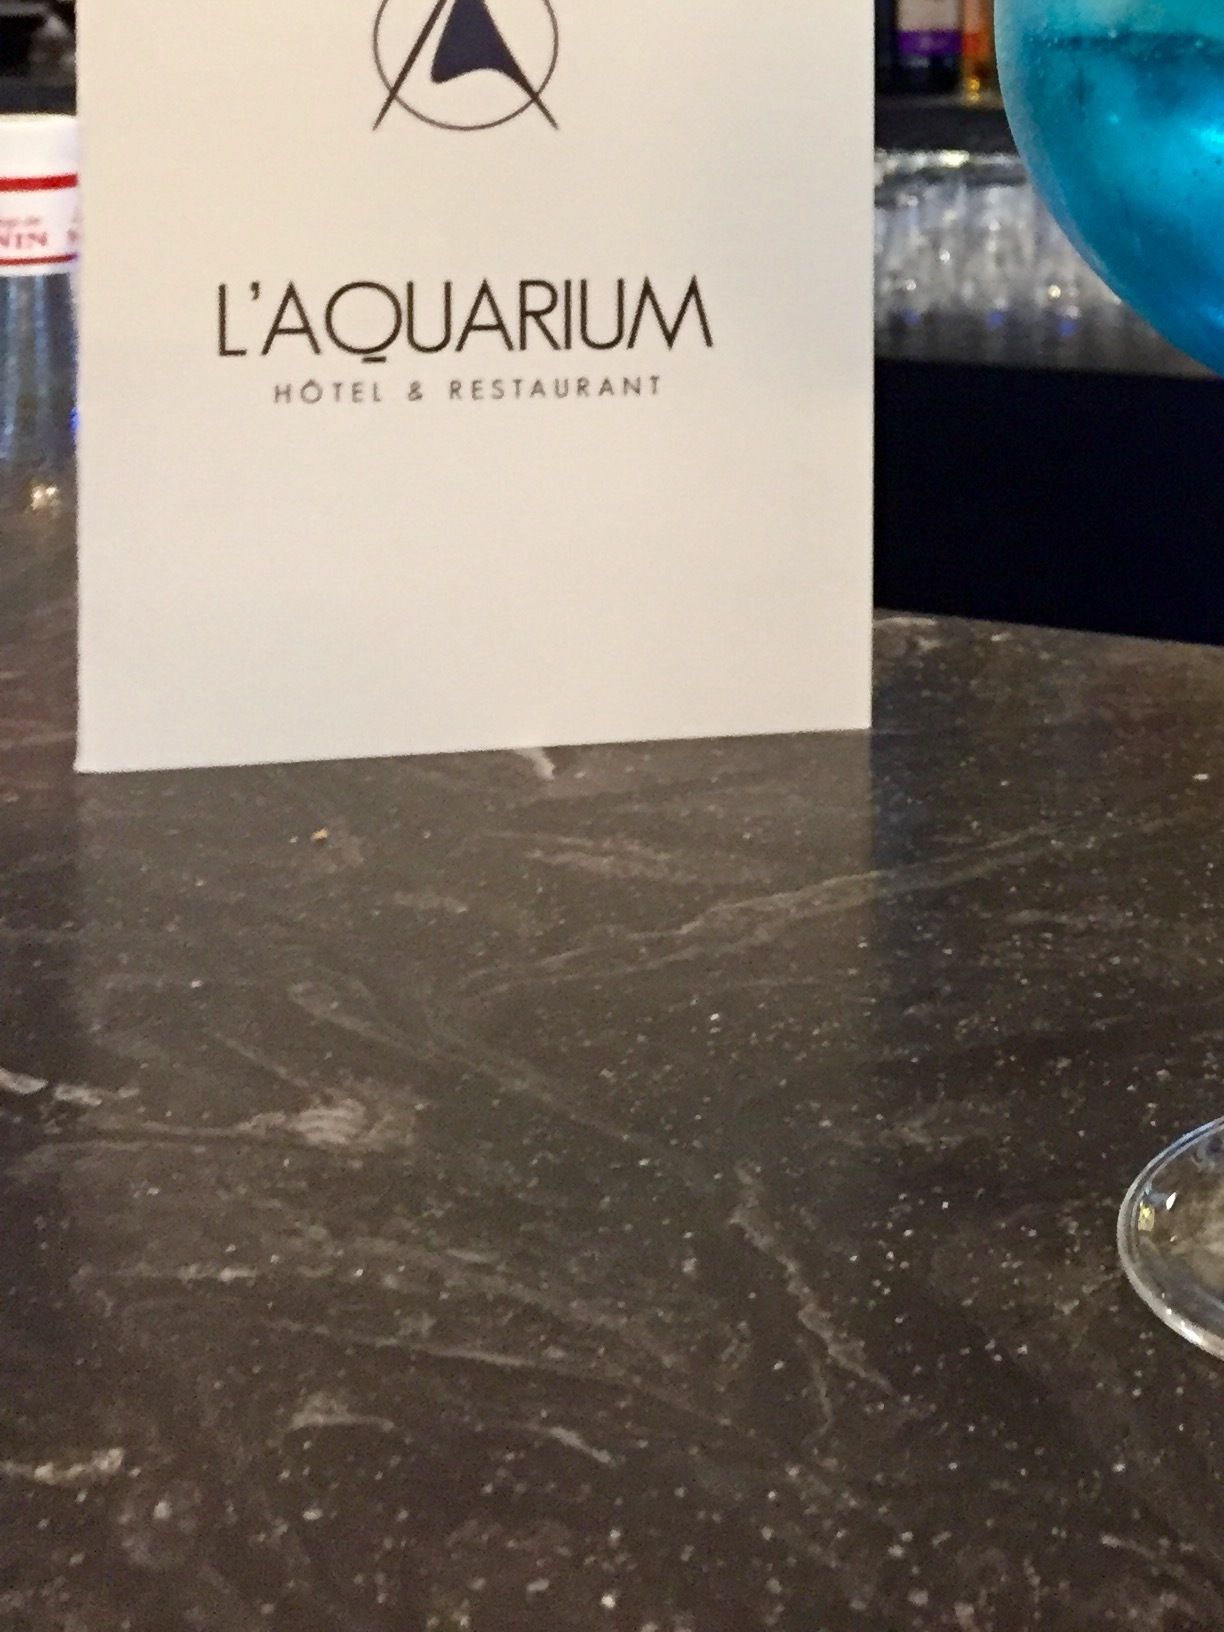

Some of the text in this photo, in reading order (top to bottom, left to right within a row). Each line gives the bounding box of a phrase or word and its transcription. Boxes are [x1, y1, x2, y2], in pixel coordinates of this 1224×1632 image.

[217, 273, 715, 365] L'AQUARIUM
[272, 374, 662, 405] HÔTEL & RESTAURANT
